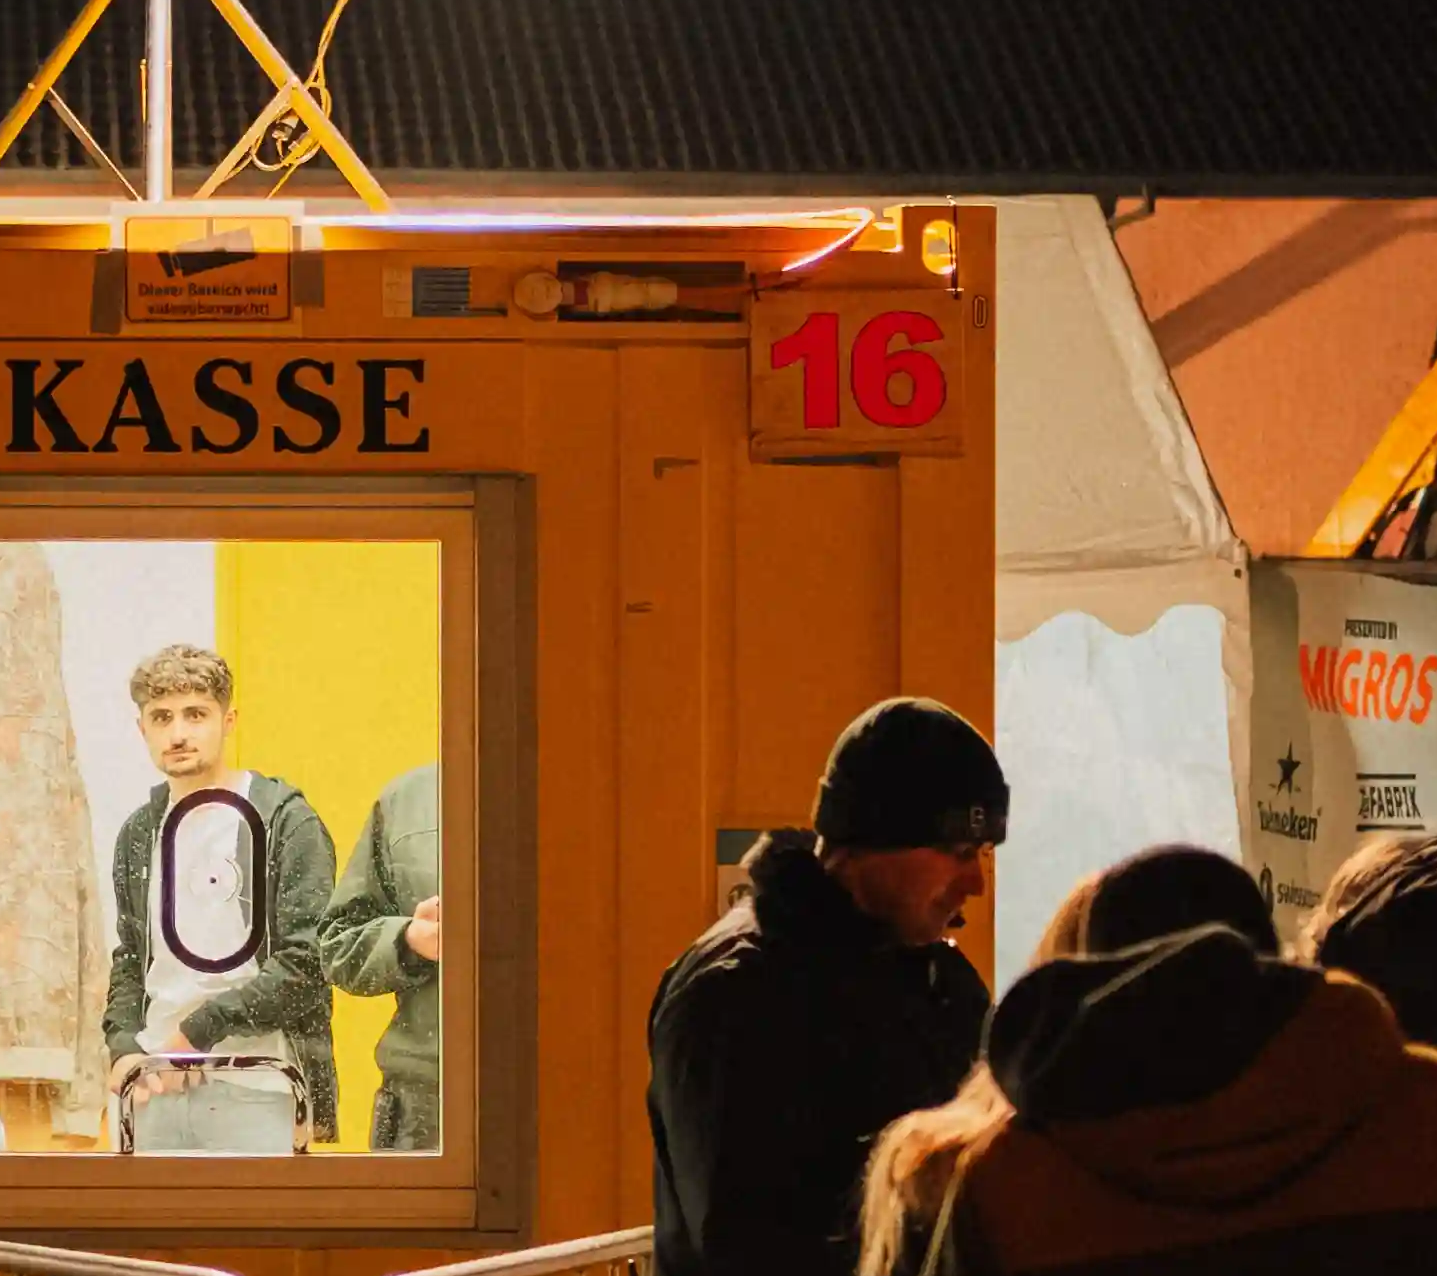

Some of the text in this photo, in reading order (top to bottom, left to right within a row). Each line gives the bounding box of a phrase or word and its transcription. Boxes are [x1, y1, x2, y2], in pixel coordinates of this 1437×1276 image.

[769, 309, 948, 430] 16
[4, 357, 430, 454] KASSE
[1344, 618, 1387, 640] PRESENTED
[1370, 785, 1421, 820] FABRIK
